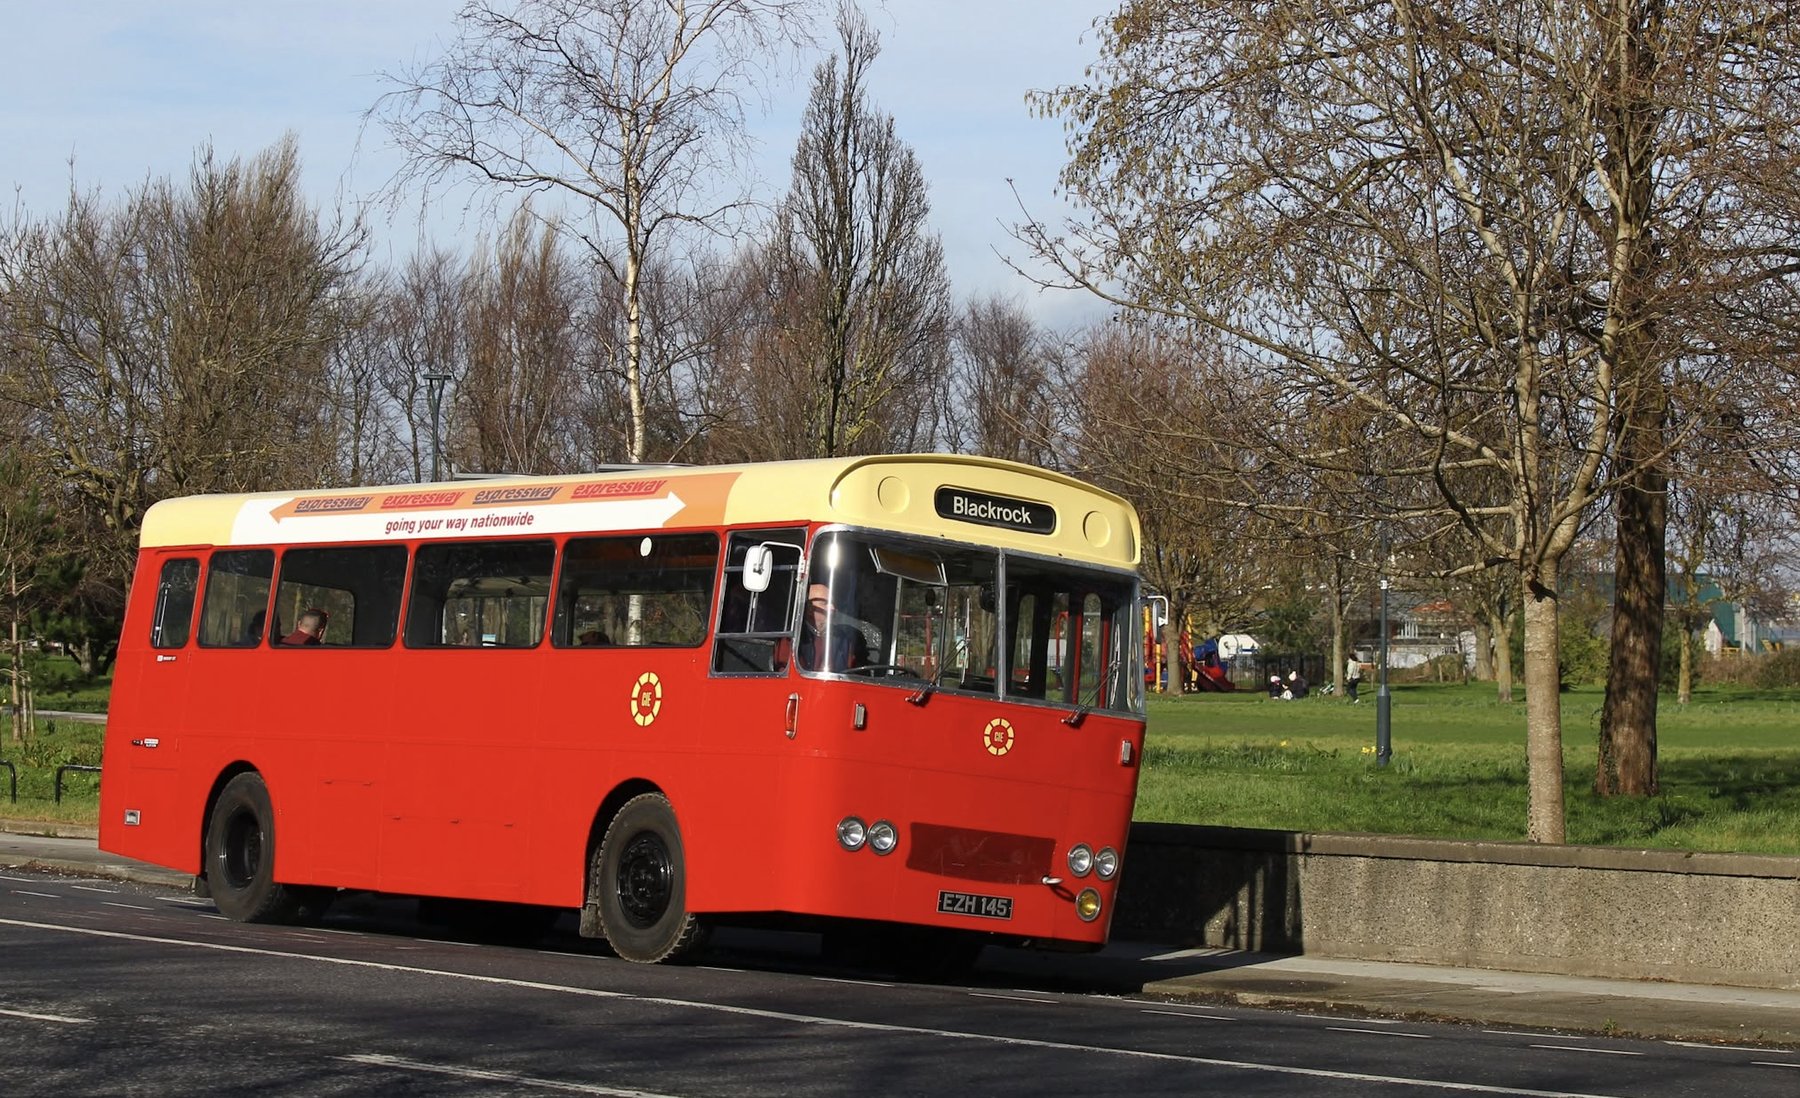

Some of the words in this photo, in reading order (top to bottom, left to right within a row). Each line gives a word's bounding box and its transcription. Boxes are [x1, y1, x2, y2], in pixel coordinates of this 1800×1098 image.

[294, 496, 373, 513] expressway
[380, 491, 465, 509] expressway
[473, 486, 563, 504] expressway
[570, 480, 667, 499] expressway
[385, 518, 415, 534] going
[418, 518, 443, 533] your
[446, 517, 470, 531] way
[470, 511, 534, 528] nationwide
[953, 496, 1032, 524] Blackrock
[942, 892, 977, 914] EZH
[981, 896, 1008, 916] 145
